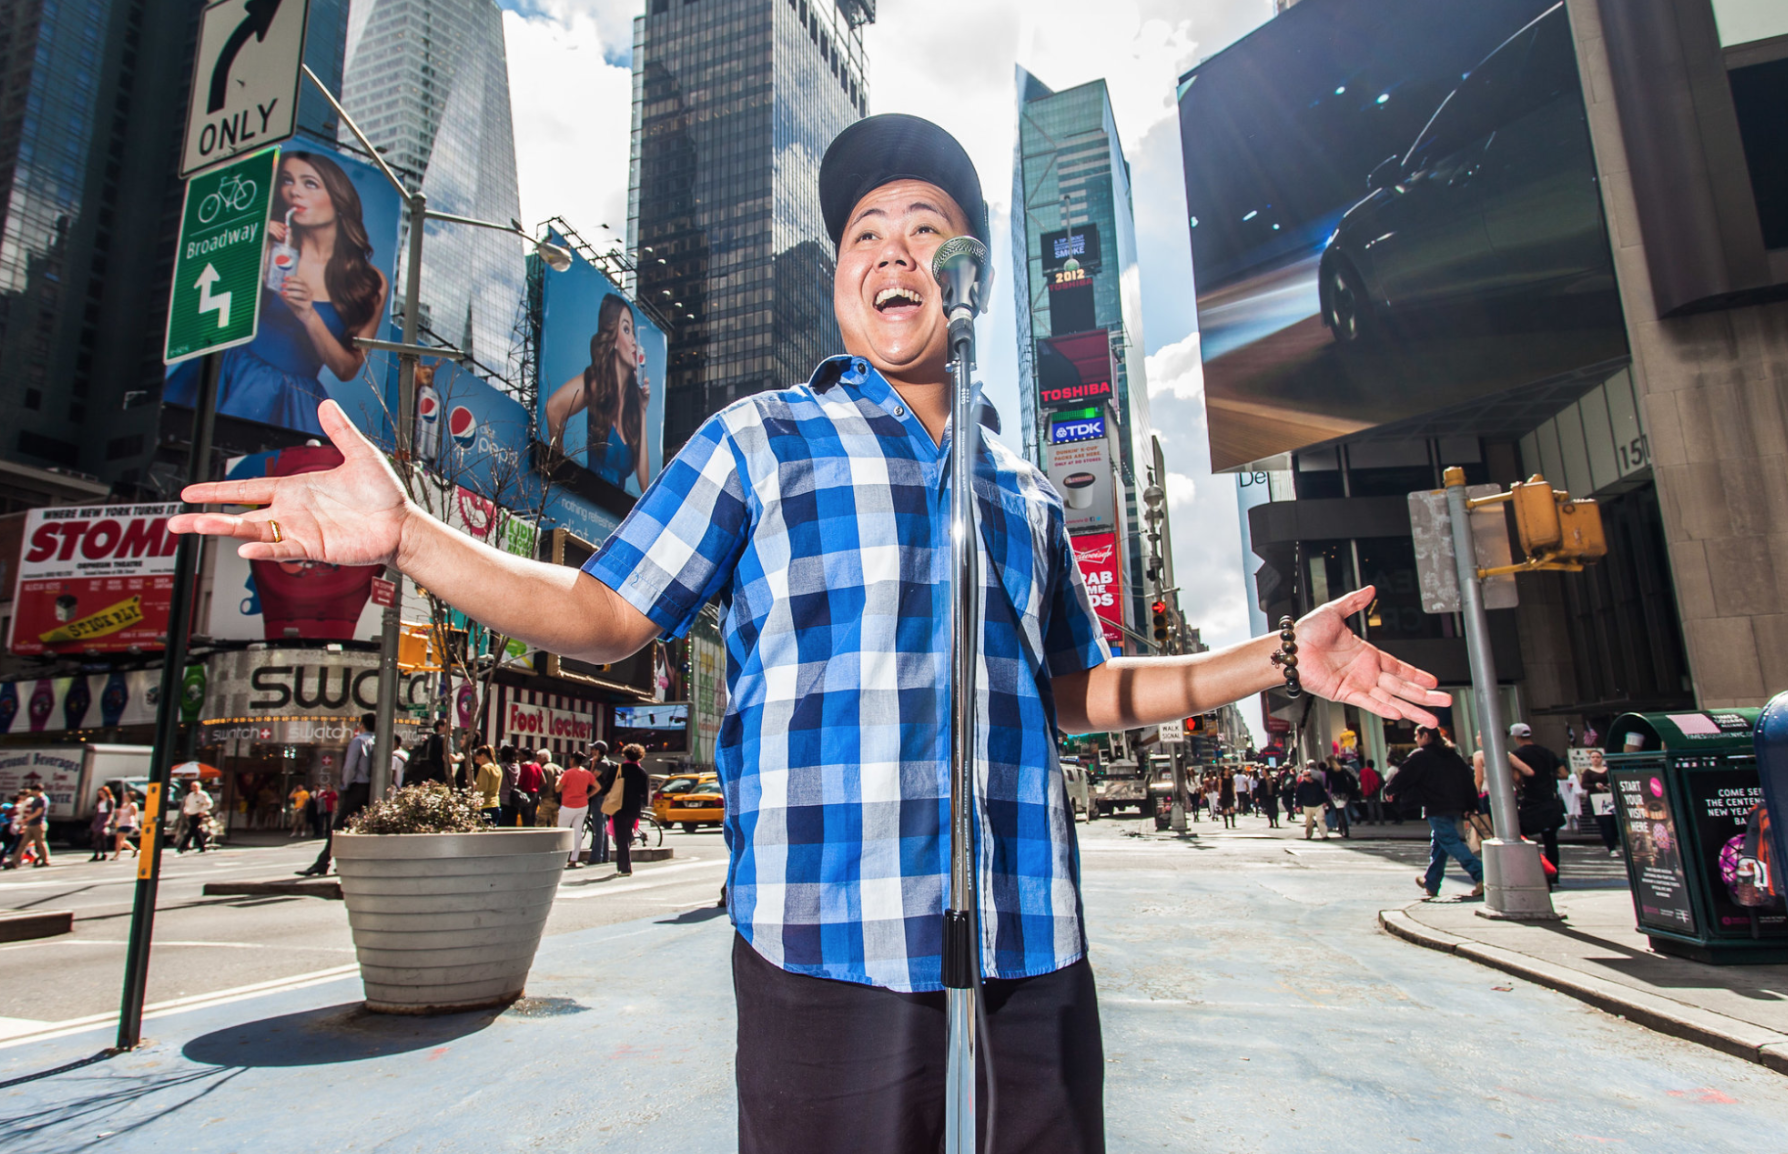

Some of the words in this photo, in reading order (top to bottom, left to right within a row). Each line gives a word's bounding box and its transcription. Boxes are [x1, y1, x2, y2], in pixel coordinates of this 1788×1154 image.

[200, 98, 278, 156] ONLY
[186, 222, 259, 260] Broadway
[1049, 276, 1093, 292] TOSHIBA
[1055, 268, 1085, 284] 2012
[1041, 381, 1110, 402] TOSHIBA
[1066, 421, 1102, 437] TDK
[43, 508, 77, 520] WHERE
[79, 507, 104, 519] NEW
[105, 506, 131, 517] YORK
[133, 504, 164, 516] TURNS
[166, 504, 178, 514] IT
[561, 498, 587, 521] nothing
[1083, 571, 1113, 586] RAB
[1087, 584, 1106, 595] ME
[1091, 594, 1114, 607] DS
[68, 614, 114, 638] STICK
[510, 704, 544, 734] Foot
[549, 709, 593, 740] Locker
[212, 725, 260, 742] swatch
[287, 723, 353, 740] swatch
[1619, 780, 1641, 792] START
[1718, 788, 1745, 798] COME
[1623, 794, 1644, 806] YOUR
[1705, 799, 1724, 807] THE
[1627, 807, 1646, 820] VISIT
[1708, 808, 1728, 817] NEW
[1730, 807, 1752, 816] YEA
[1734, 817, 1747, 825] BA
